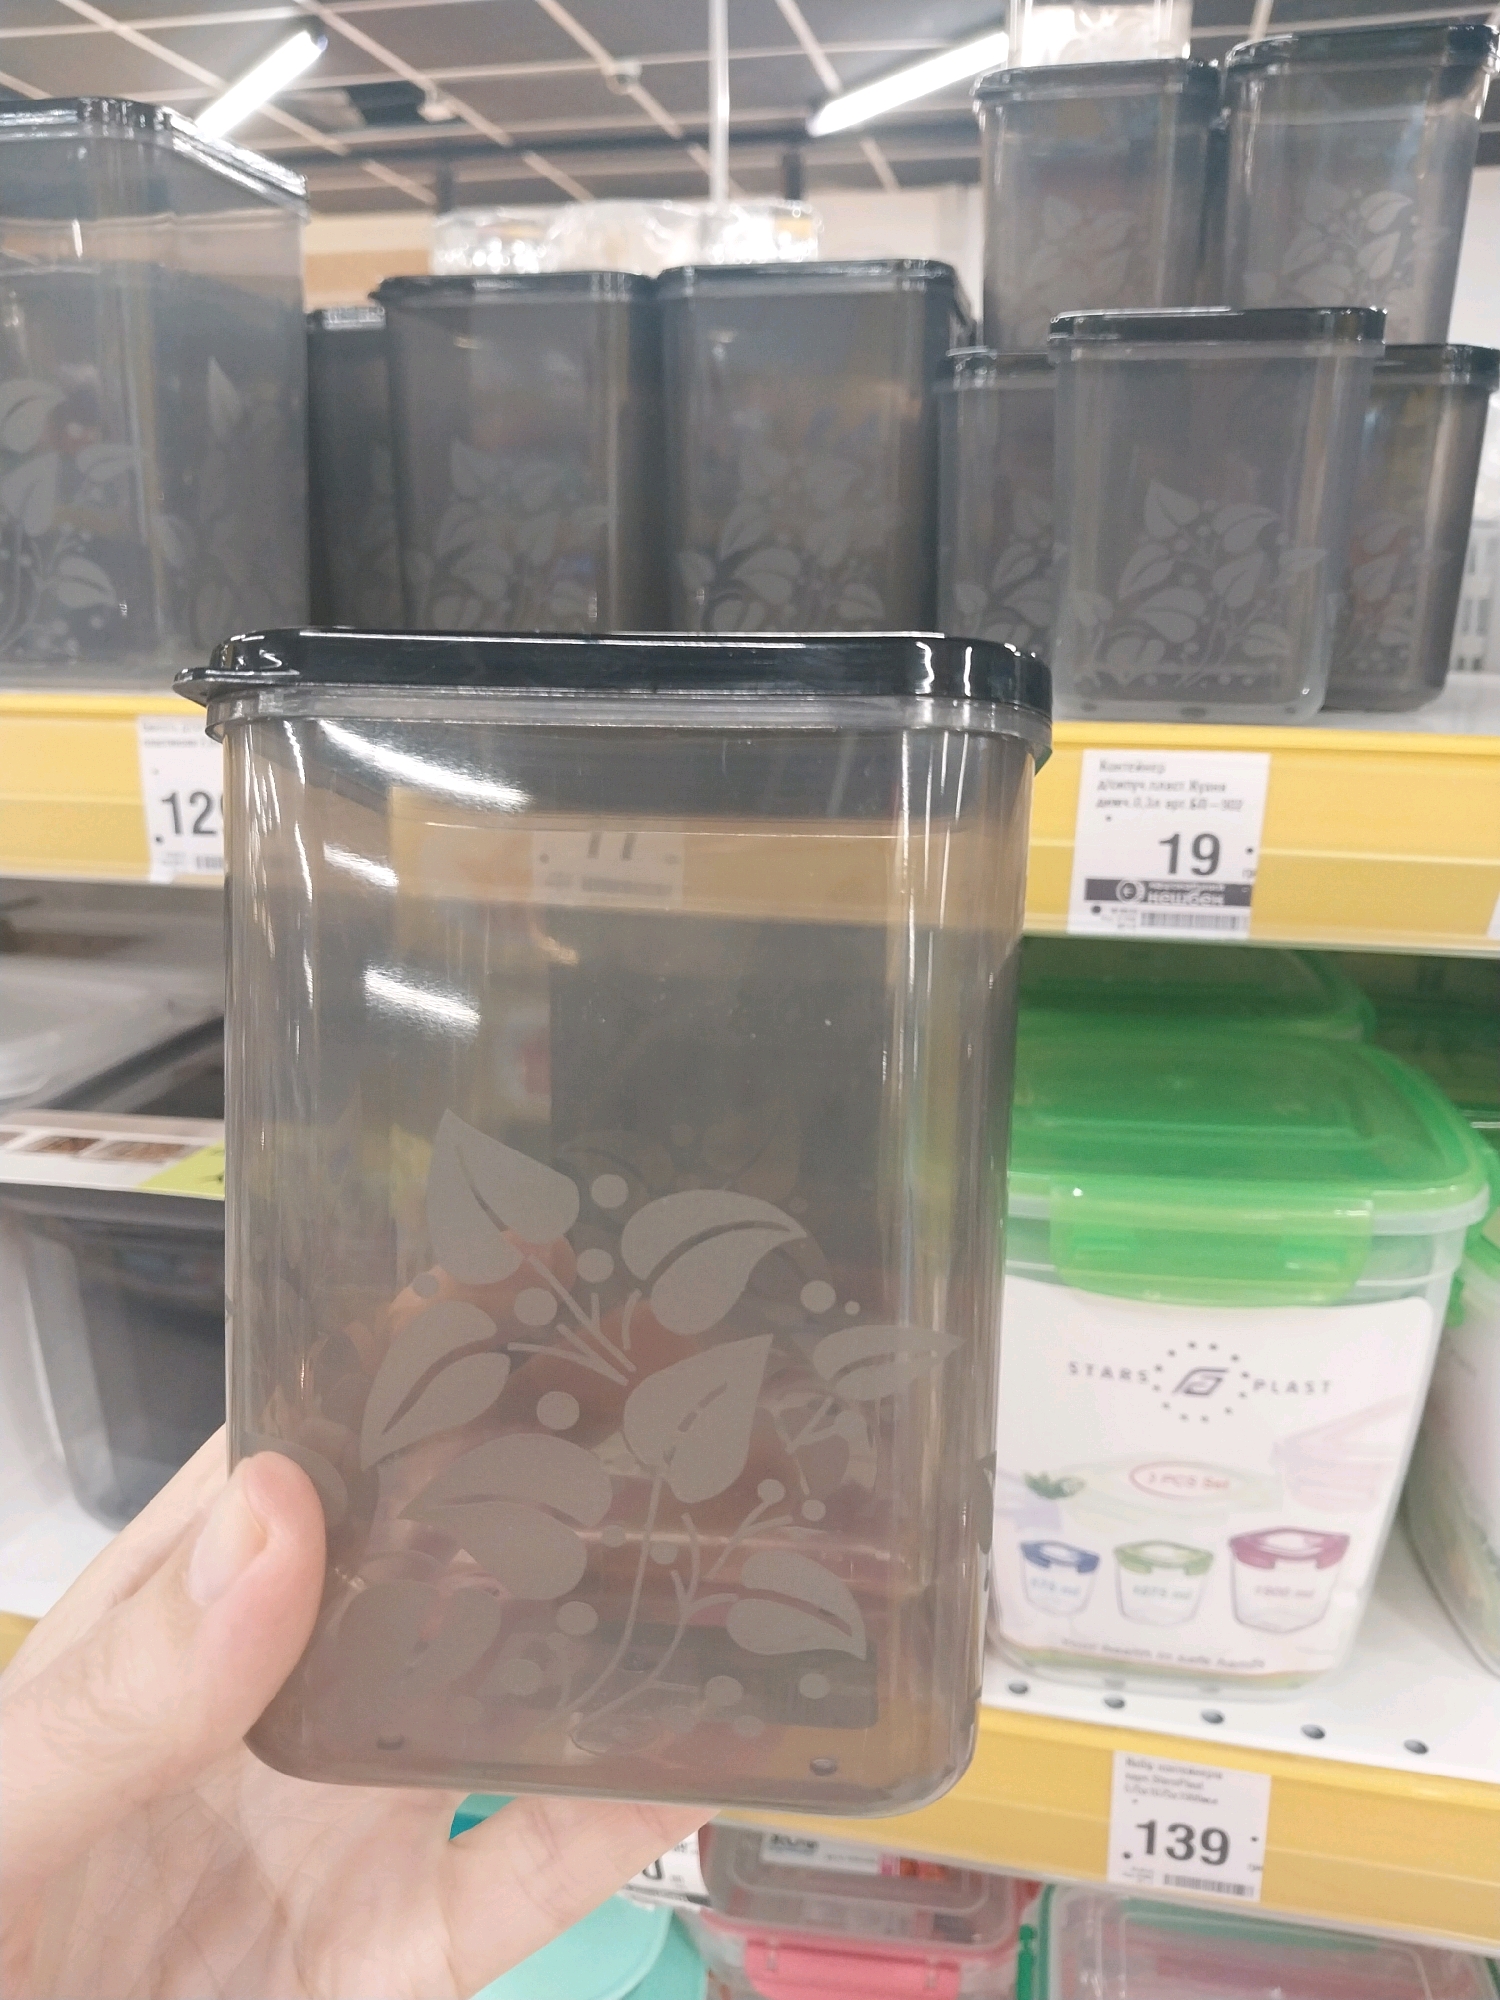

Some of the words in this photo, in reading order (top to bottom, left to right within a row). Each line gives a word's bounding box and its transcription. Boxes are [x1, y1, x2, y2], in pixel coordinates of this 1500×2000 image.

[161, 782, 223, 835] 12
[1158, 832, 1221, 876] 19
[1068, 1360, 1150, 1384] STARS
[1252, 1378, 1333, 1395] PLAST
[1136, 1819, 1230, 1866] 139
